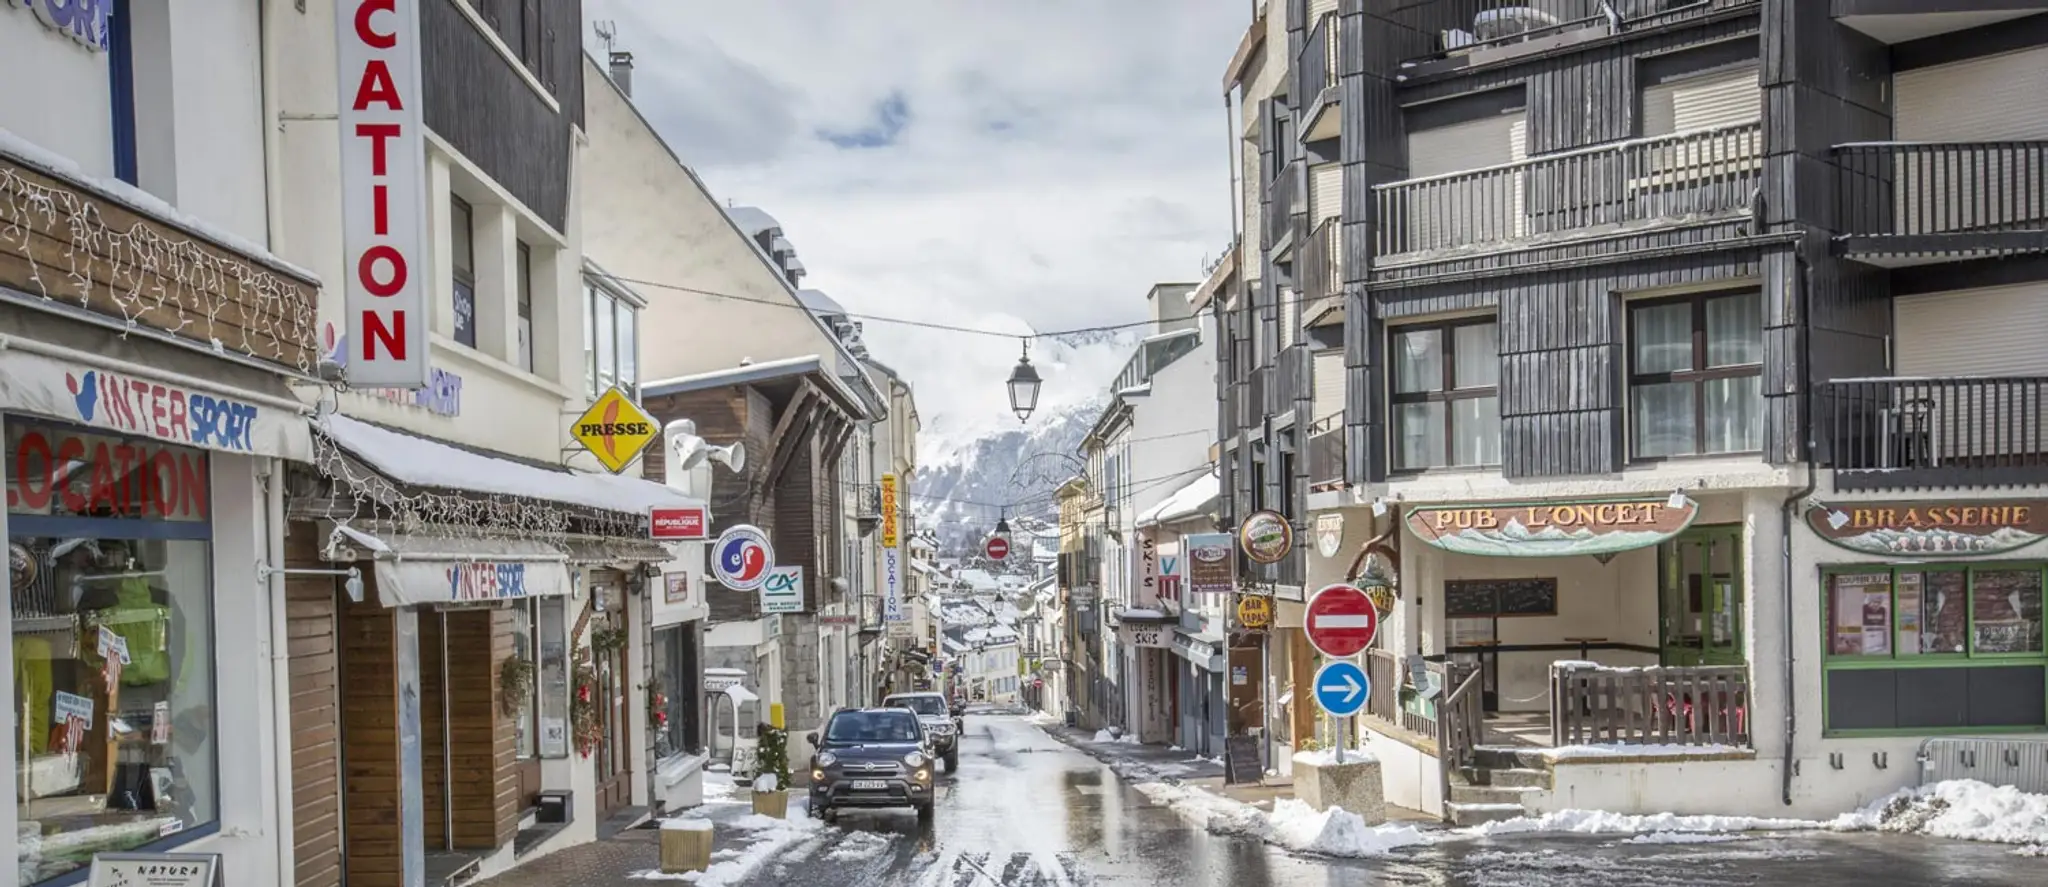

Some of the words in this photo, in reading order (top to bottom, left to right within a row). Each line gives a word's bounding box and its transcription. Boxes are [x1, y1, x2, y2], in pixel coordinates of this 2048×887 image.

[99, 372, 258, 451] INTERSPORT
[581, 422, 649, 436] PRESSE
[884, 483, 895, 536] KODAK
[1435, 508, 1499, 530] PUB
[1526, 502, 1664, 528] L'ONCET
[1852, 506, 2031, 528] BRASSERIE
[459, 562, 527, 599] INTERSPORT
[887, 550, 897, 612] LOCATION
[137, 865, 198, 876] NATURA
